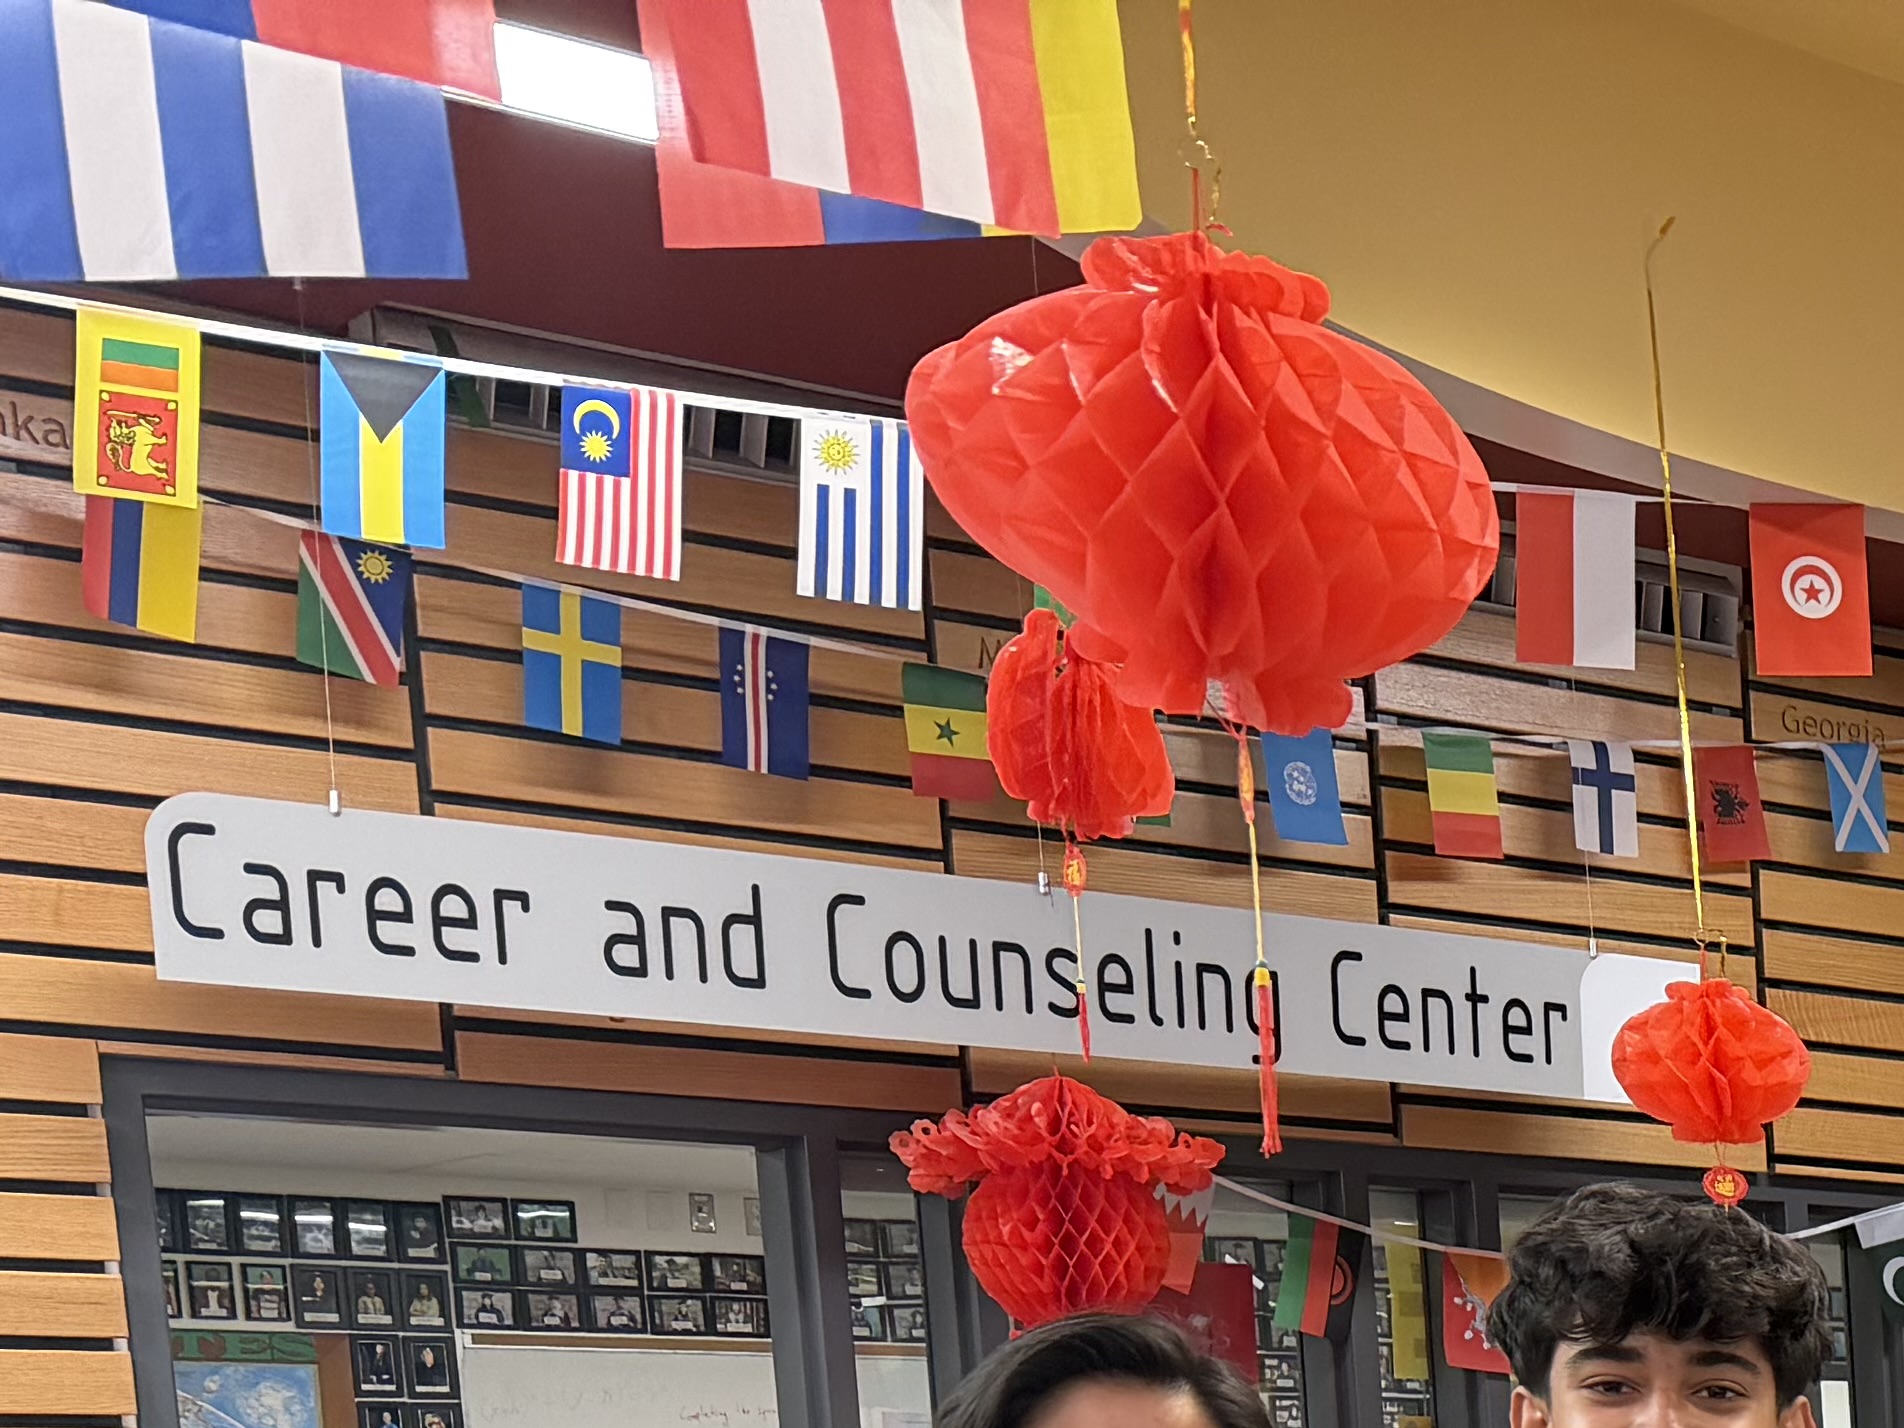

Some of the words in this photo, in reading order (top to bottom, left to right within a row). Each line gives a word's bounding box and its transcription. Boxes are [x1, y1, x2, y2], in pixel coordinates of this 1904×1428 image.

[1781, 703, 1887, 751] Georgia
[166, 821, 530, 966] Career
[602, 883, 768, 990] and
[826, 892, 1283, 1067] Counseling
[1330, 949, 1569, 1066] Center
